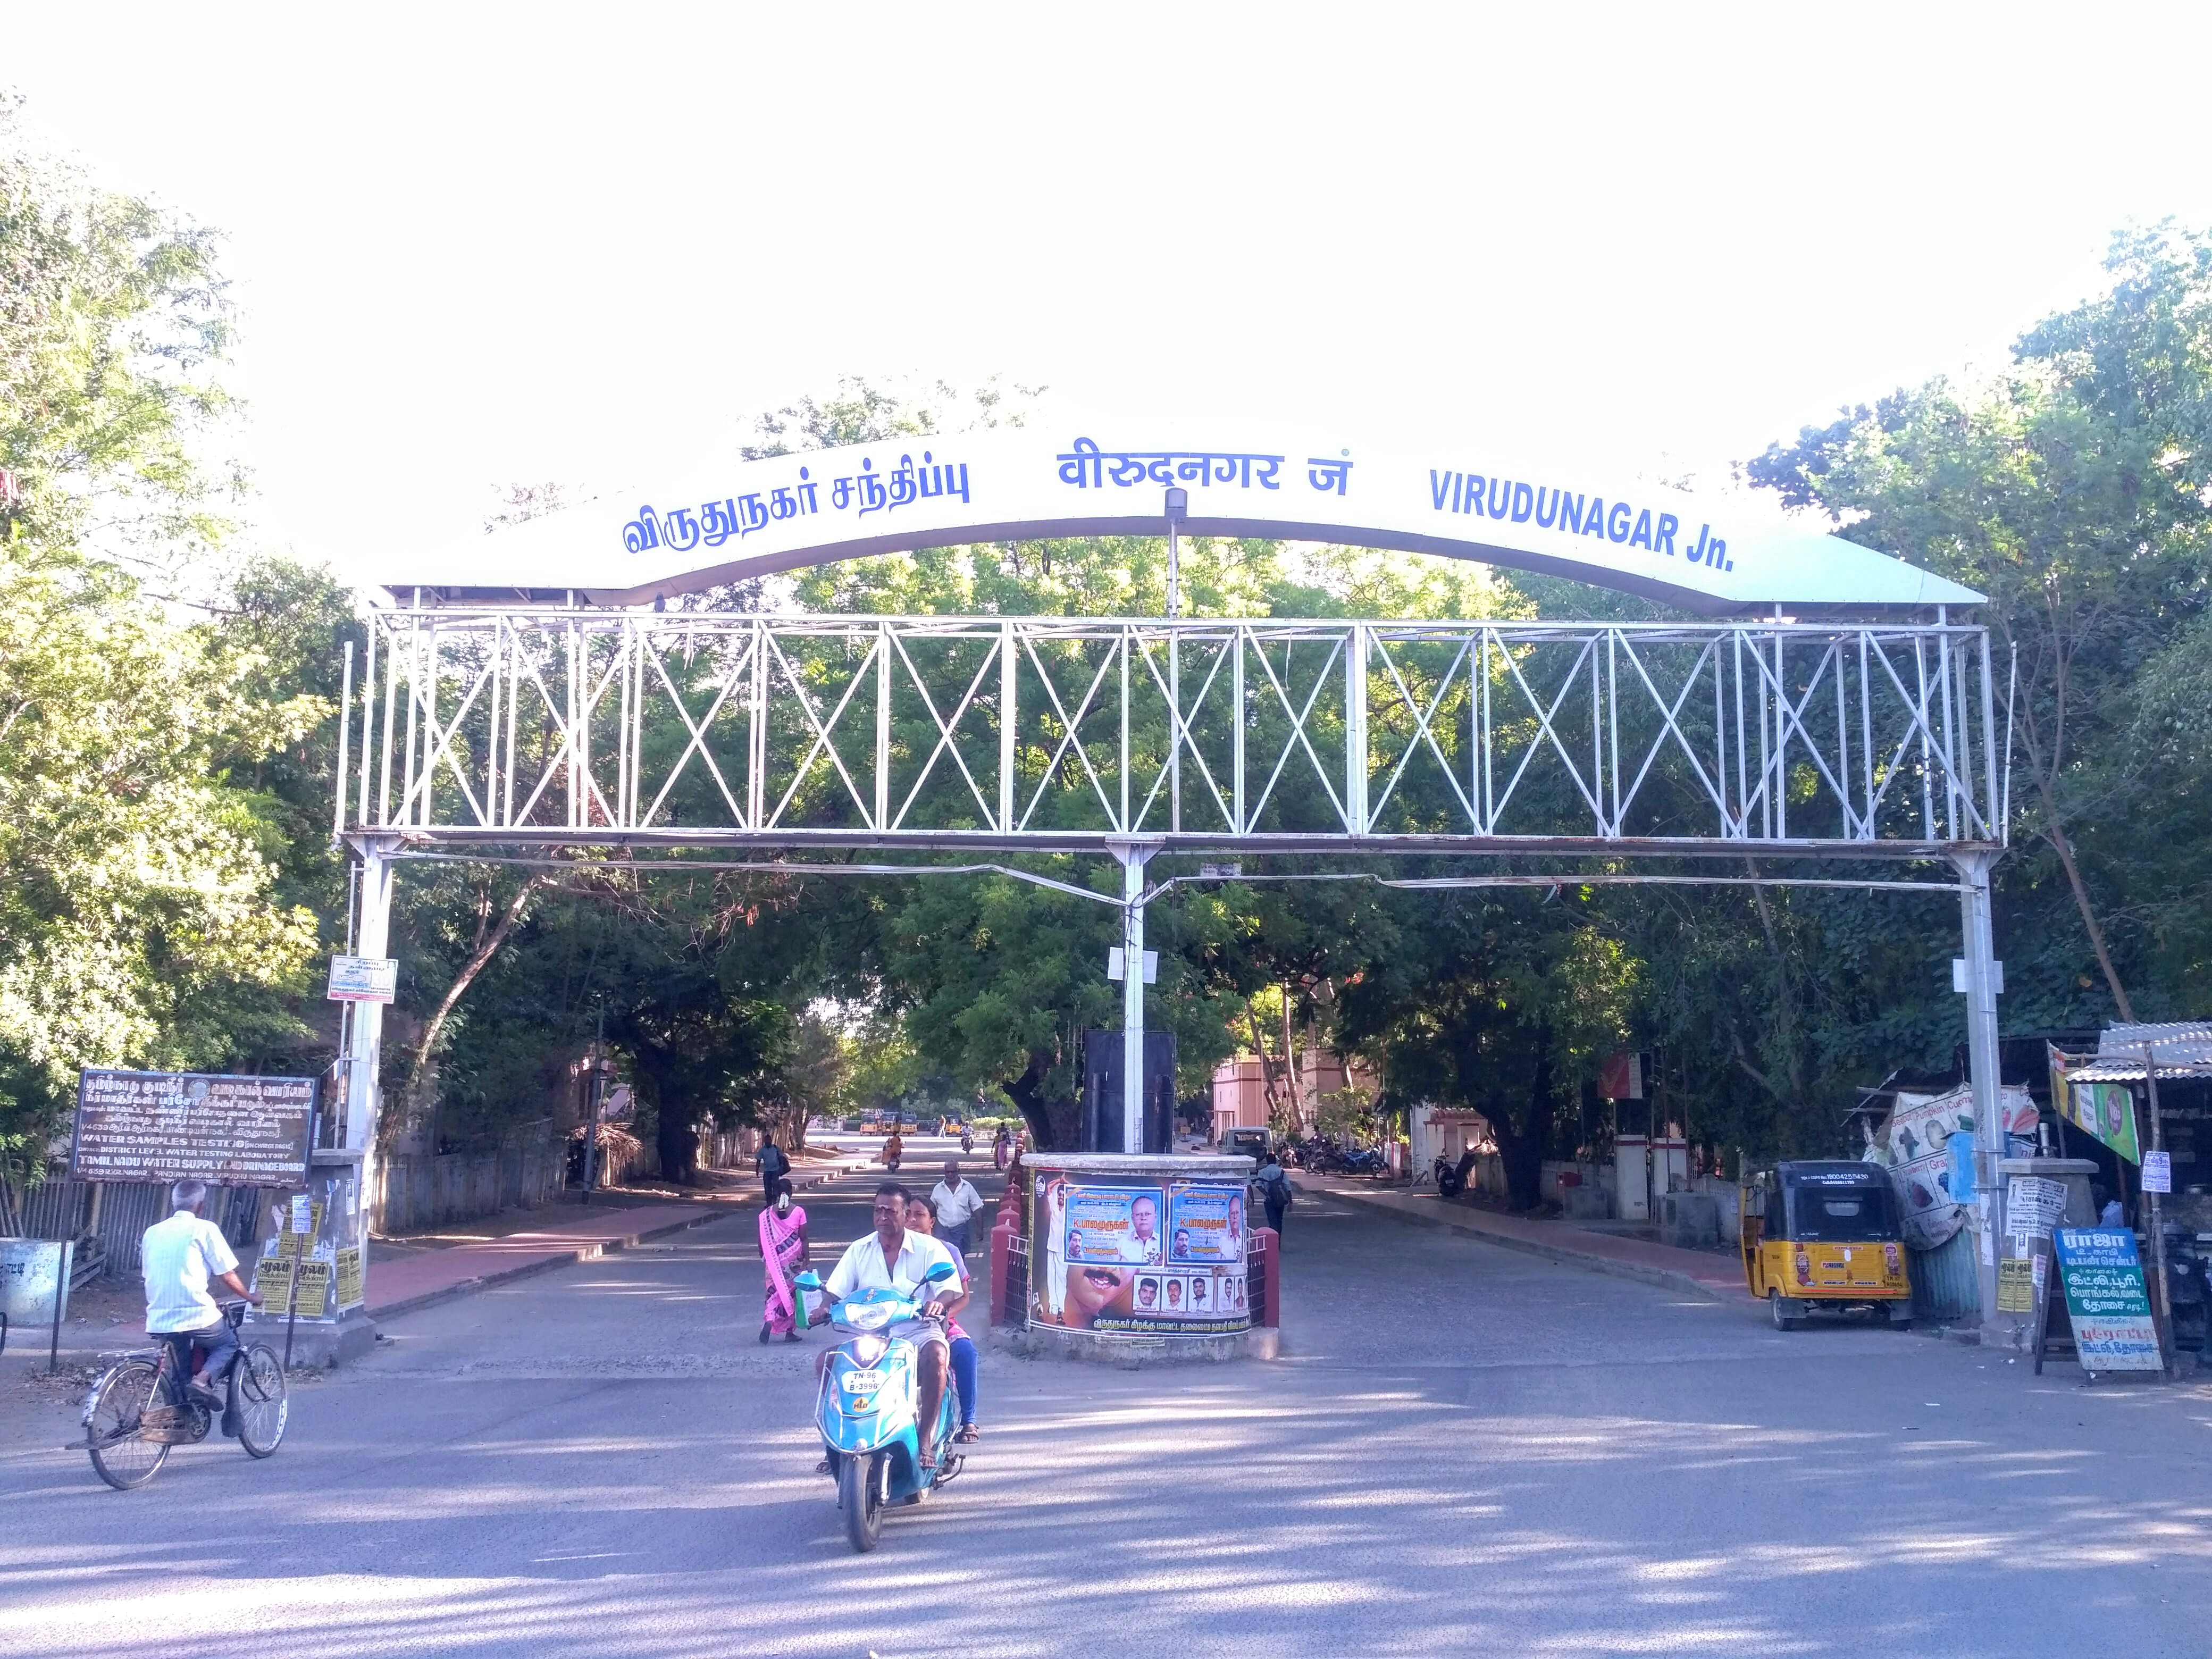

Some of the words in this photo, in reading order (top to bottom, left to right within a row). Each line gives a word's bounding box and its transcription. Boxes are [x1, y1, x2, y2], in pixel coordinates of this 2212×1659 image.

[622, 466, 818, 554] விருதுநகர்
[832, 450, 970, 518] சந்திப்பு
[1430, 470, 1679, 556] VIRUDUNAGAR
[1687, 524, 1734, 573] Jn.
[86, 1074, 139, 1093] தமிழ்நாடு
[142, 1077, 184, 1094] குடிநீர்
[211, 1080, 262, 1097] வடிகால்
[263, 1082, 312, 1098] வாரியம்
[1915, 1105, 1945, 1121] Pumpkin
[81, 1134, 124, 1144] WATER
[127, 1136, 188, 1145] SAMPLES
[79, 1155, 113, 1166] TAMIL
[114, 1156, 140, 1167] NADU
[142, 1158, 180, 1168] WATER
[182, 1159, 223, 1170] SUPPLY
[2063, 1233, 2125, 1249] ராஜா
[2082, 1299, 2125, 1312] தோசை
[1094, 1318, 1129, 1330] விருதுநகர்
[1131, 1320, 1155, 1331] கிழக்கு
[1157, 1322, 1179, 1330] மாவட்ட
